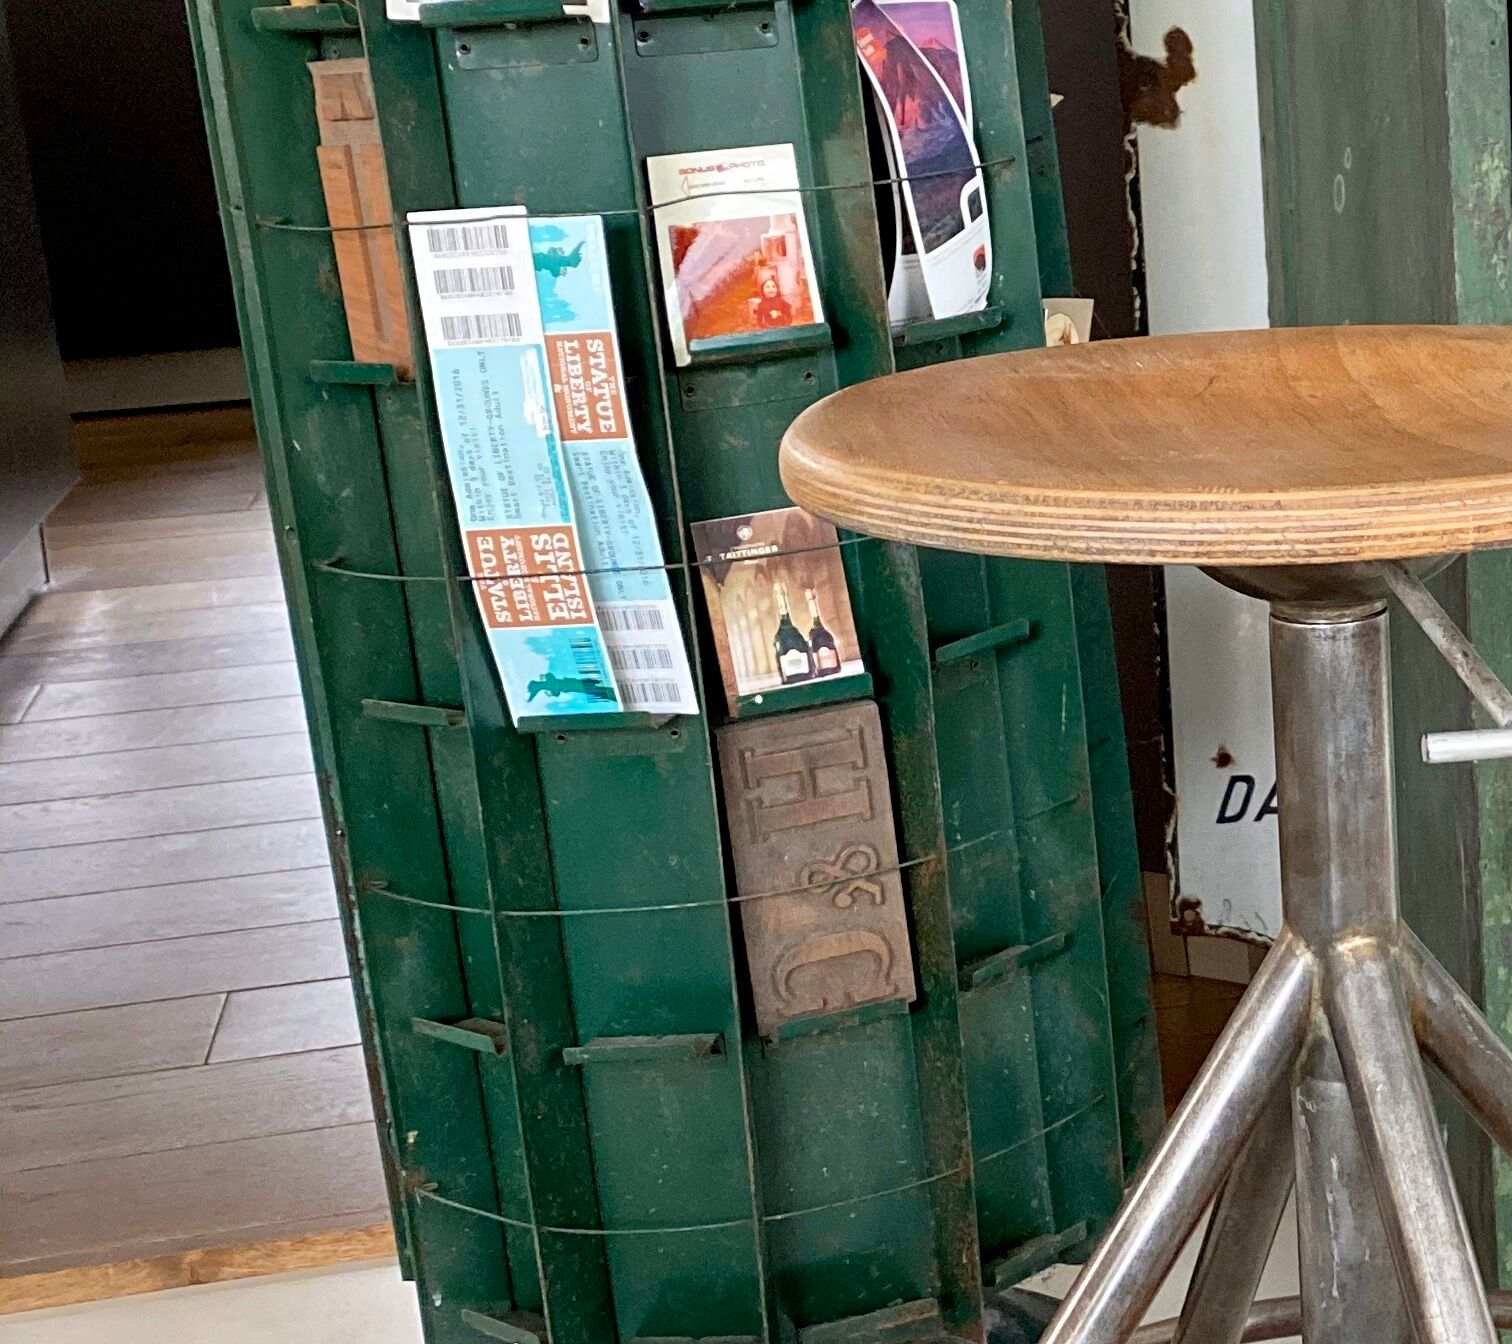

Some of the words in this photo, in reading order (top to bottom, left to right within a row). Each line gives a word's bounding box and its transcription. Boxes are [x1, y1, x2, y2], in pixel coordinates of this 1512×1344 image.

[566, 338, 592, 435] LIBERTY
[587, 337, 616, 434] STATUE
[476, 534, 512, 624] STATUE
[499, 533, 533, 622] LIBERTY
[551, 531, 586, 620] ISLAND
[719, 545, 779, 561] TAITTINGER
